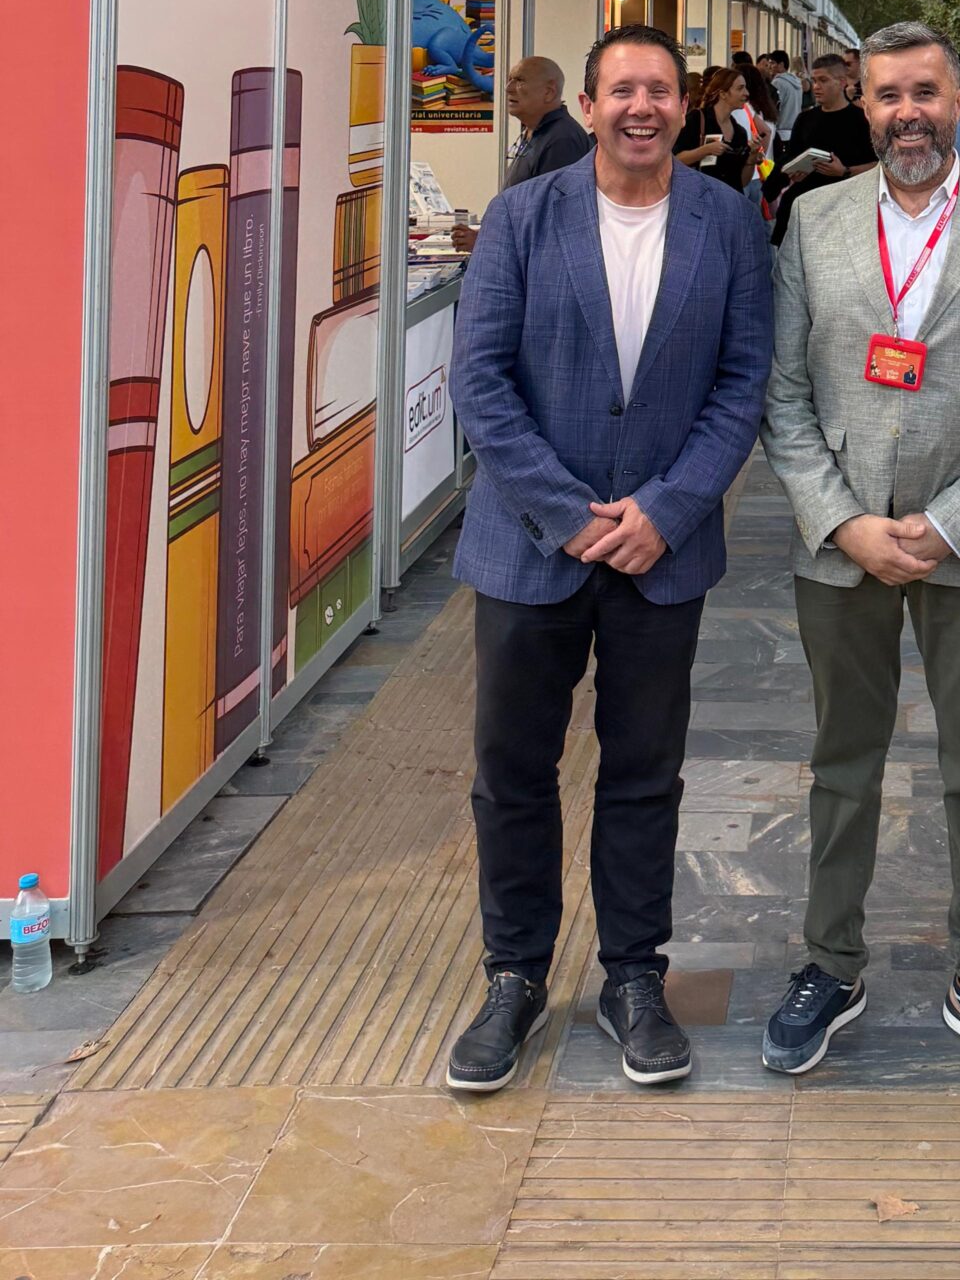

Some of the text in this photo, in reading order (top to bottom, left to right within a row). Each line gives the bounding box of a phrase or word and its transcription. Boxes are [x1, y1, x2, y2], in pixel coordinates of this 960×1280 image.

[242, 212, 255, 259] libro.
[255, 223, 265, 279] Dickinson
[243, 262, 253, 286] un
[242, 290, 254, 324] que
[241, 329, 252, 374] nave
[240, 379, 251, 433] mejor
[237, 437, 251, 473] hay
[239, 475, 248, 499] no
[235, 558, 248, 609] viajar
[233, 611, 246, 658] Para
